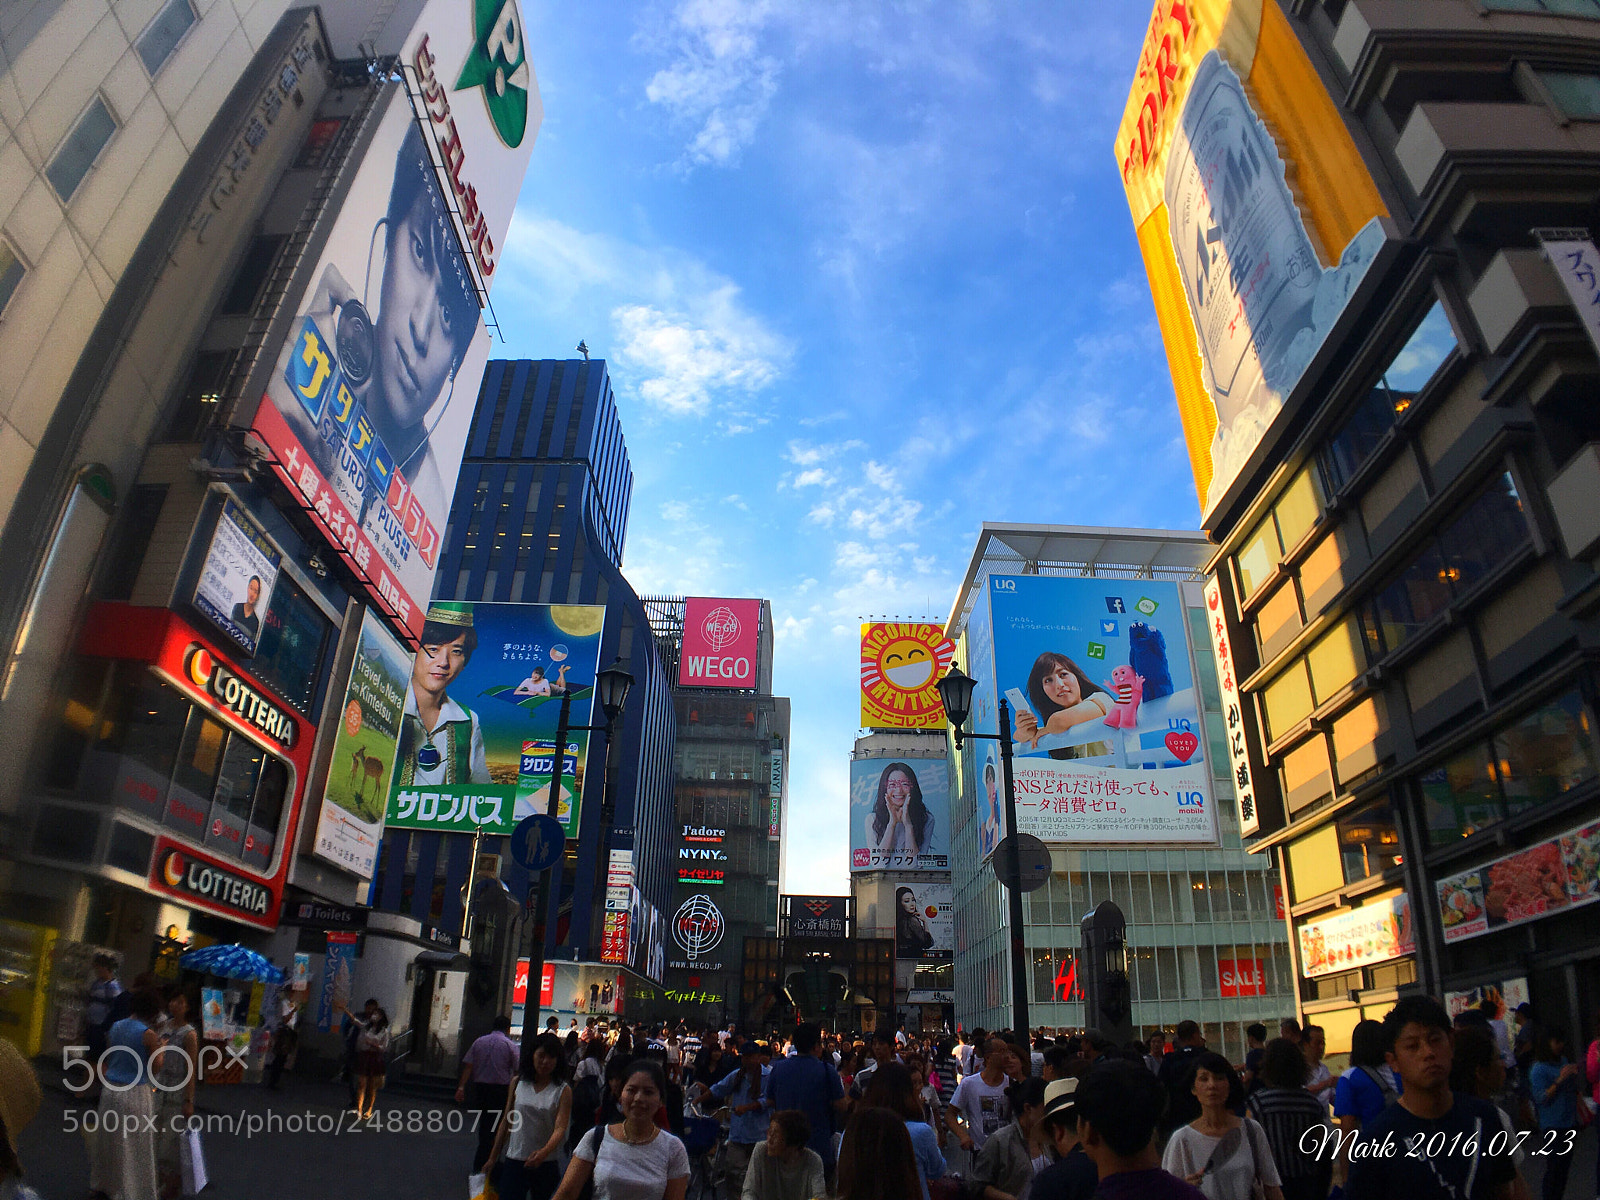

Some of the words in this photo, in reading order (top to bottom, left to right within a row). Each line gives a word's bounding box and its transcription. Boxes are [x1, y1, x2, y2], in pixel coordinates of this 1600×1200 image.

[320, 417, 378, 512] SATURDAY
[994, 579, 1016, 591] UQ
[861, 623, 943, 660] NICONICO
[502, 652, 542, 661] きもちよさ。
[688, 655, 749, 679] WEGO
[351, 681, 360, 694] on
[358, 653, 380, 688] Travel
[385, 682, 402, 709] Nara
[213, 665, 294, 746] LOTTERIA
[1168, 718, 1191, 732] UQ
[523, 757, 575, 773] サロンス
[772, 758, 781, 789] NYNY
[396, 790, 503, 825] サロンパス
[1176, 791, 1204, 808] UQ
[682, 824, 726, 837] J'adore
[871, 856, 914, 866] ワクワク
[678, 868, 725, 880] サイゼリヤ
[187, 863, 267, 914] LOTTERIA
[314, 906, 351, 922] Toilets
[1222, 970, 1263, 987] SALE
[664, 990, 723, 1005] マツモトキヨシ
